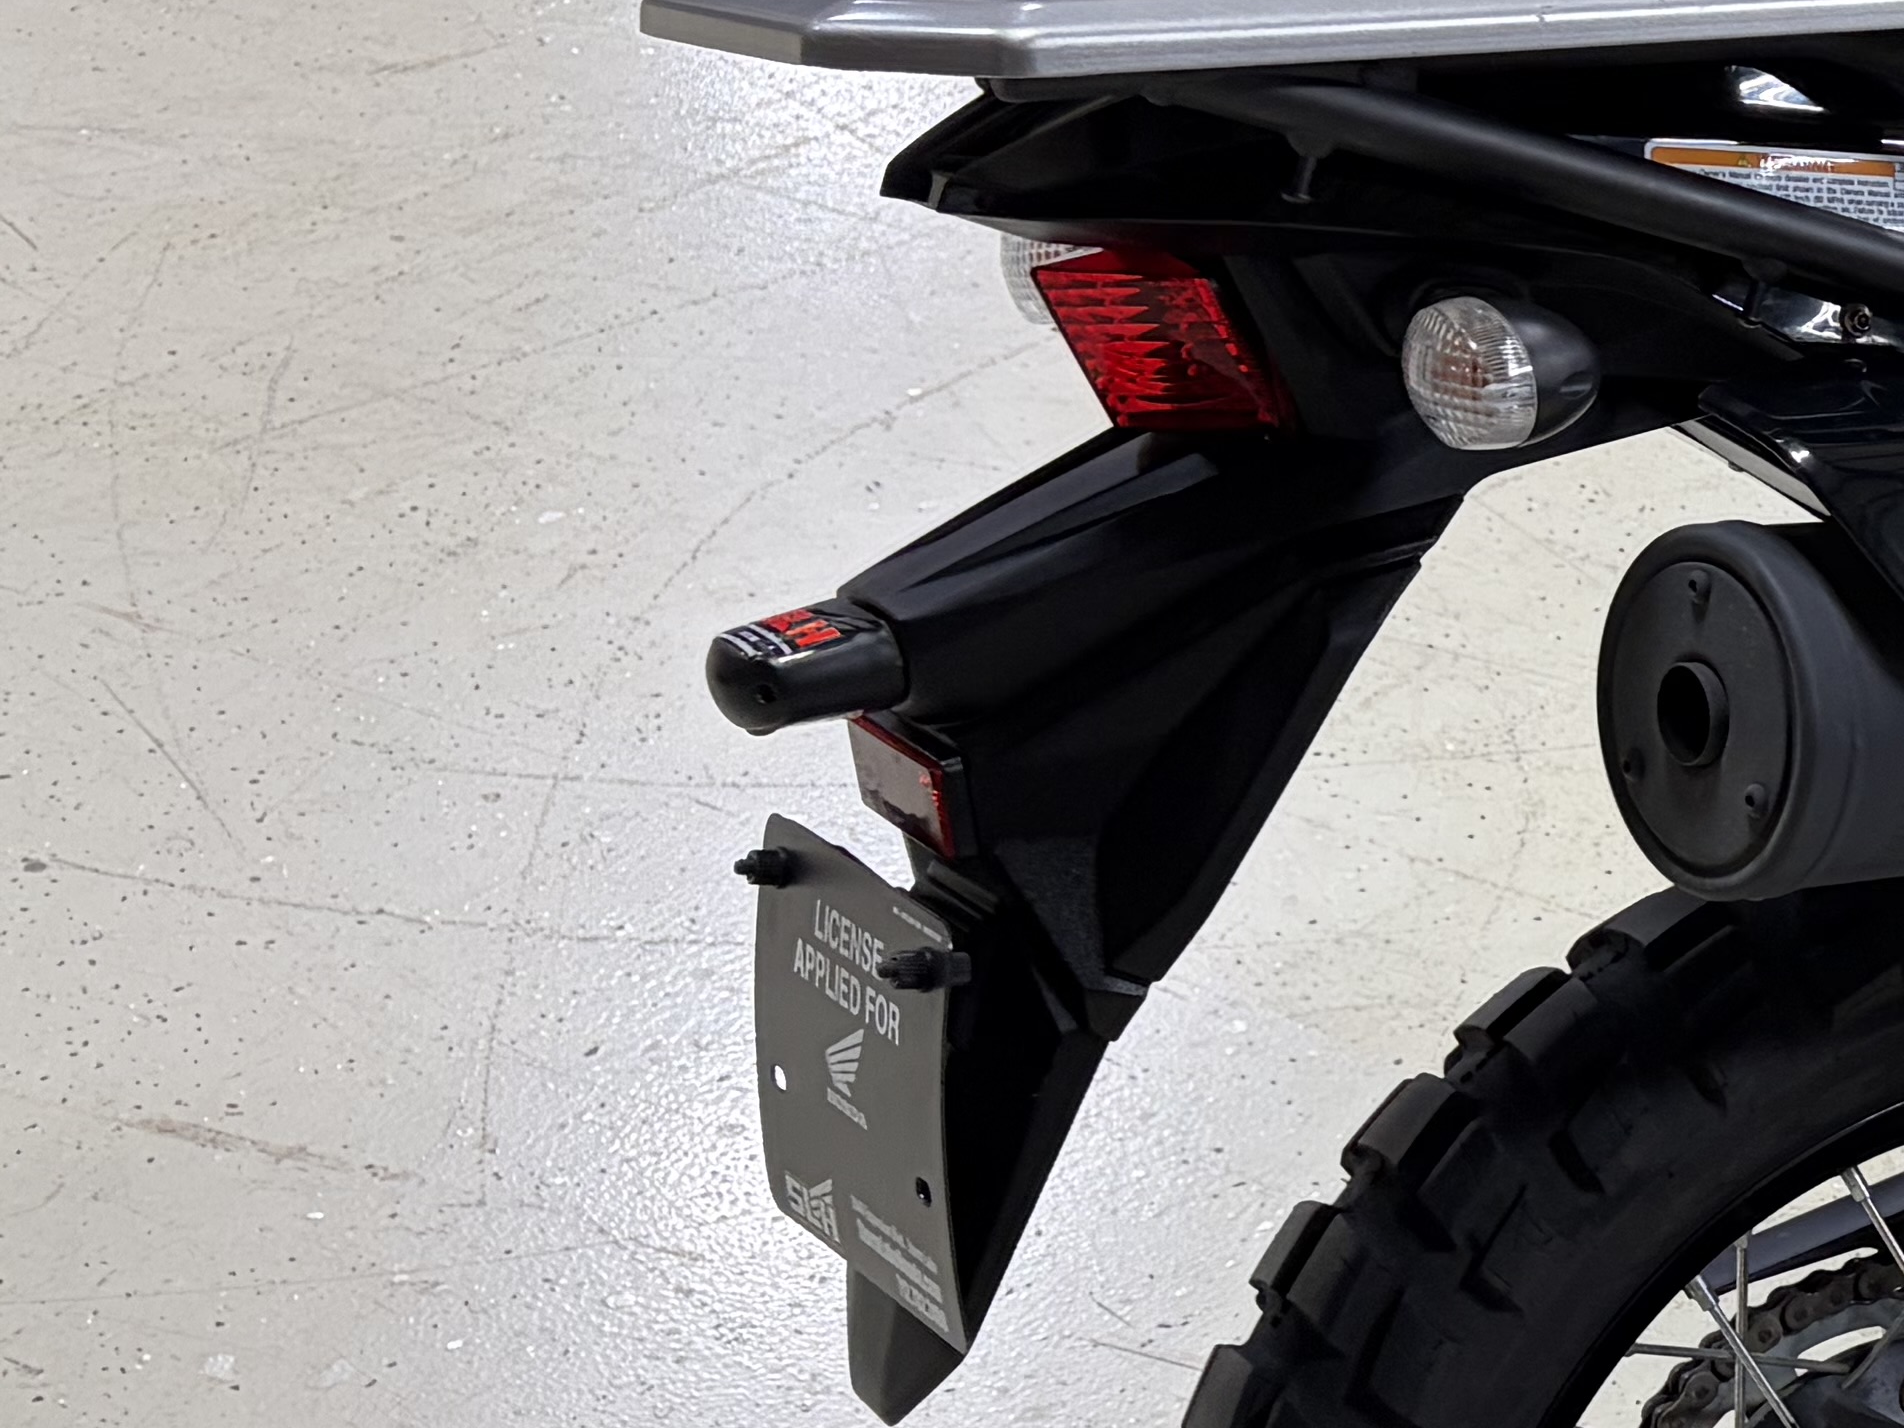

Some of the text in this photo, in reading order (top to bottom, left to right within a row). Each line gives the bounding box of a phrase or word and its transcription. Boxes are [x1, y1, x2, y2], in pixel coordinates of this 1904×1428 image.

[814, 899, 885, 981] LICENSE
[794, 938, 900, 1046] APPLIED FOR
